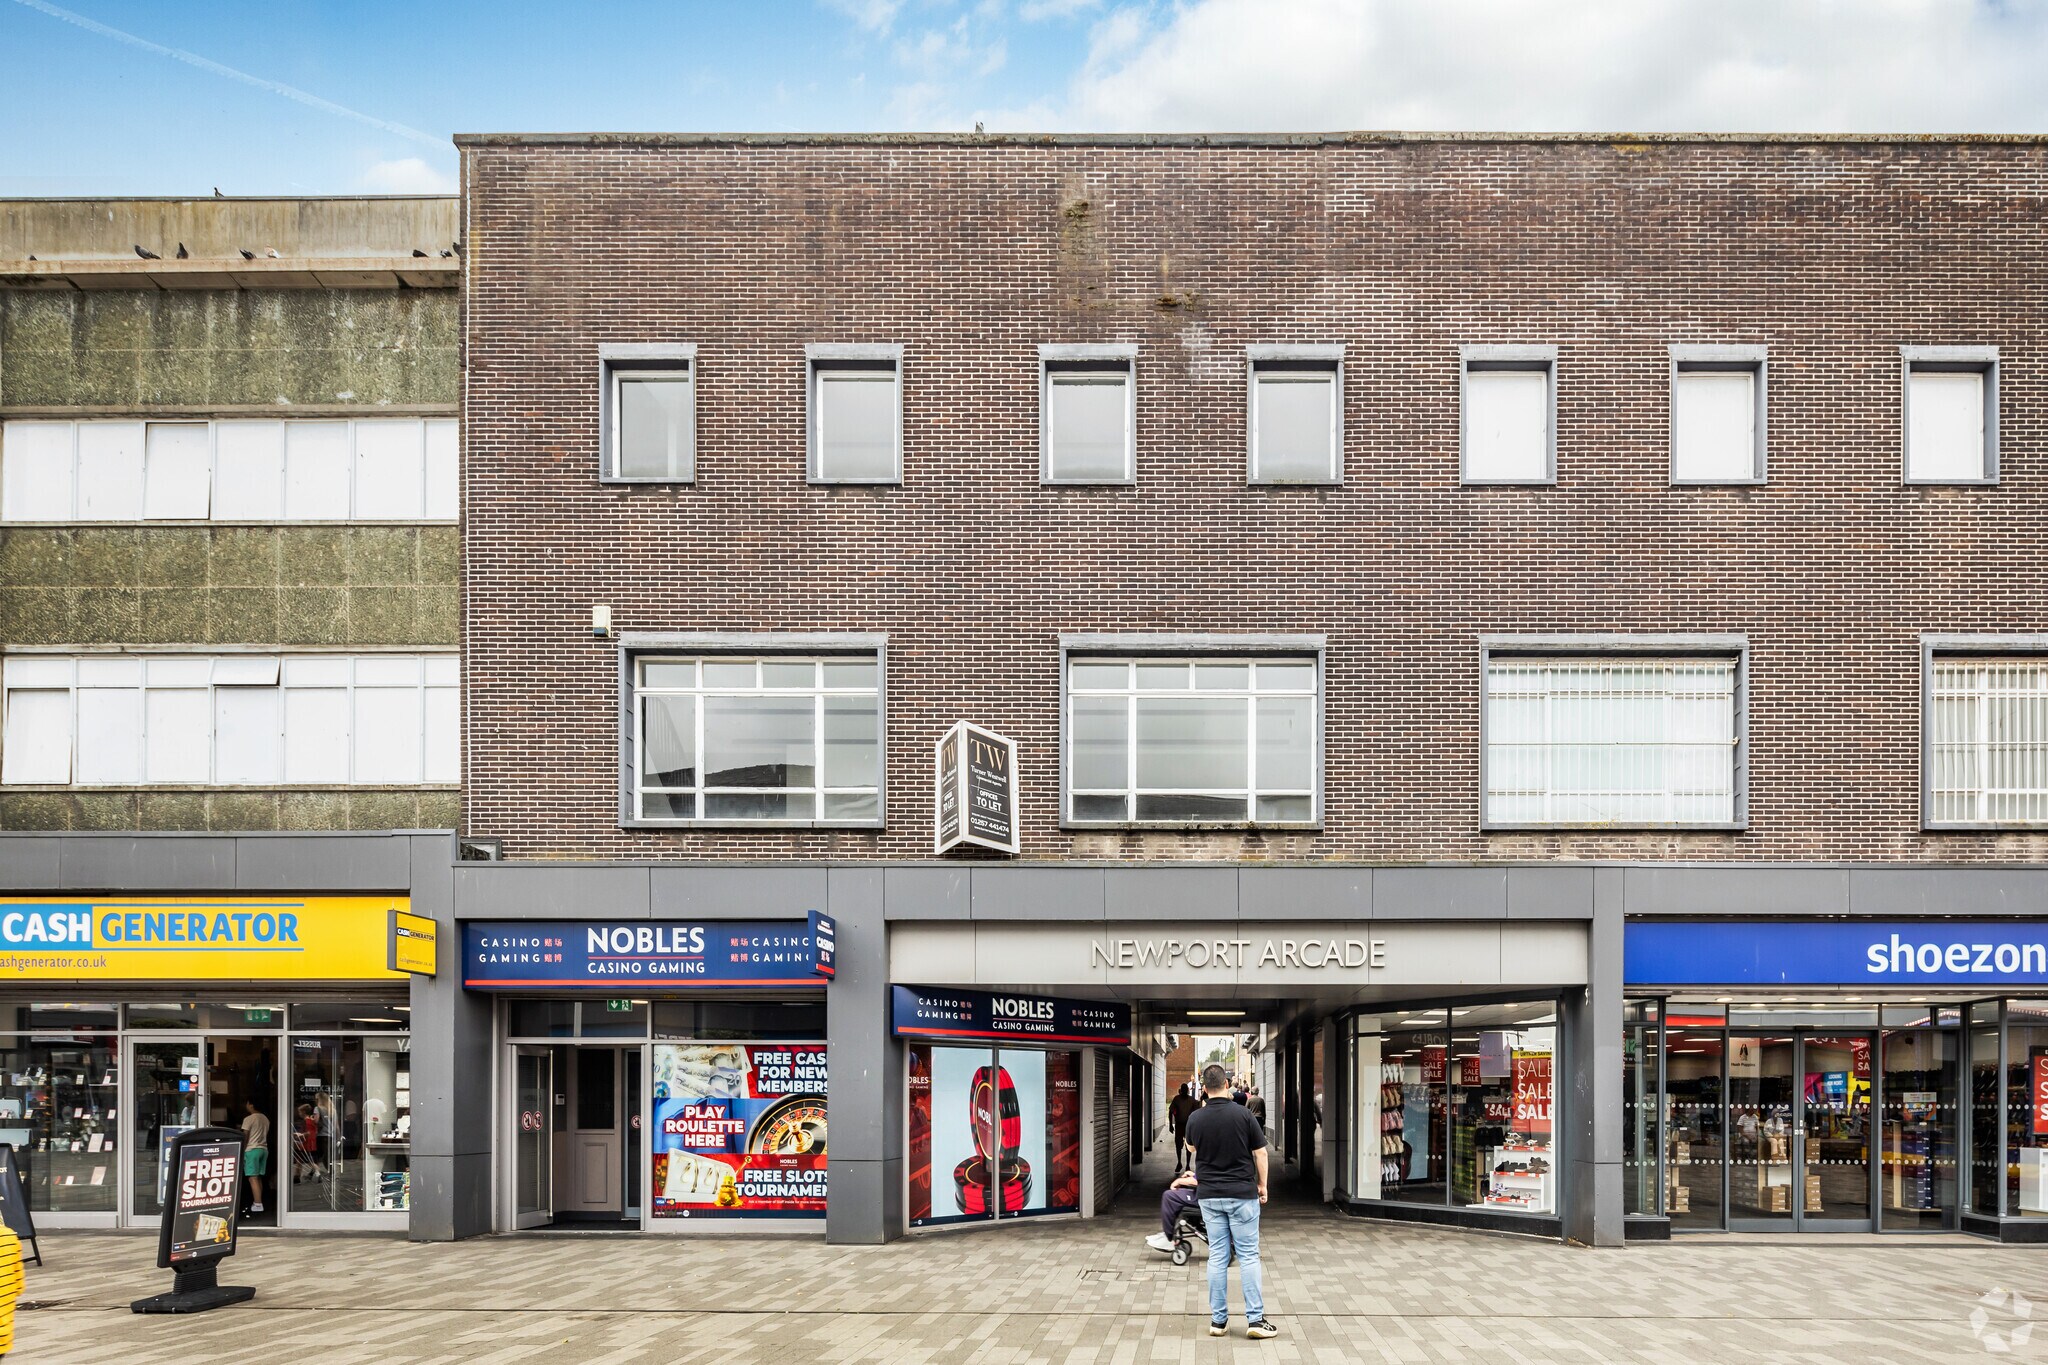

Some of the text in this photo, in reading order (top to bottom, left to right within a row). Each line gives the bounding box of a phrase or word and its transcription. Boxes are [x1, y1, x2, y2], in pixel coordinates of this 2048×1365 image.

[970, 738, 1006, 771] TW
[980, 790, 998, 801] OFFICES
[976, 796, 1002, 812] TO LET
[3, 912, 299, 943] CASH GENERATOR
[410, 931, 434, 941] GENERATOR
[480, 938, 540, 947] CASINO
[587, 927, 705, 953] NOBLES
[479, 953, 540, 963] GAMING
[1091, 939, 1387, 968] NEWPORT ARCADE
[1867, 933, 2047, 973] shoezon
[587, 962, 705, 974] CASINO GAMING
[918, 998, 958, 1008] CASINO
[992, 997, 1055, 1019] NOBLES
[917, 1010, 958, 1020] GAMING
[1083, 1010, 1115, 1019] CASINO
[992, 1021, 1055, 1032] CASINO GAMING
[1083, 1020, 1116, 1029] GAMING
[754, 1052, 792, 1065] FREE
[1423, 1052, 1442, 1060] SALE
[760, 1066, 827, 1079] FOR NEW
[1423, 1070, 1442, 1078] SALE
[1055, 1080, 1077, 1088] NOBLES
[685, 1106, 725, 1119] PLAY
[665, 1120, 745, 1133] ROULETTE
[684, 1134, 725, 1147] HERE
[183, 1157, 236, 1181] FREE
[744, 1170, 782, 1182] FREE
[182, 1176, 234, 1200] SLOT
[181, 1195, 232, 1208] TOURNAMENTS
